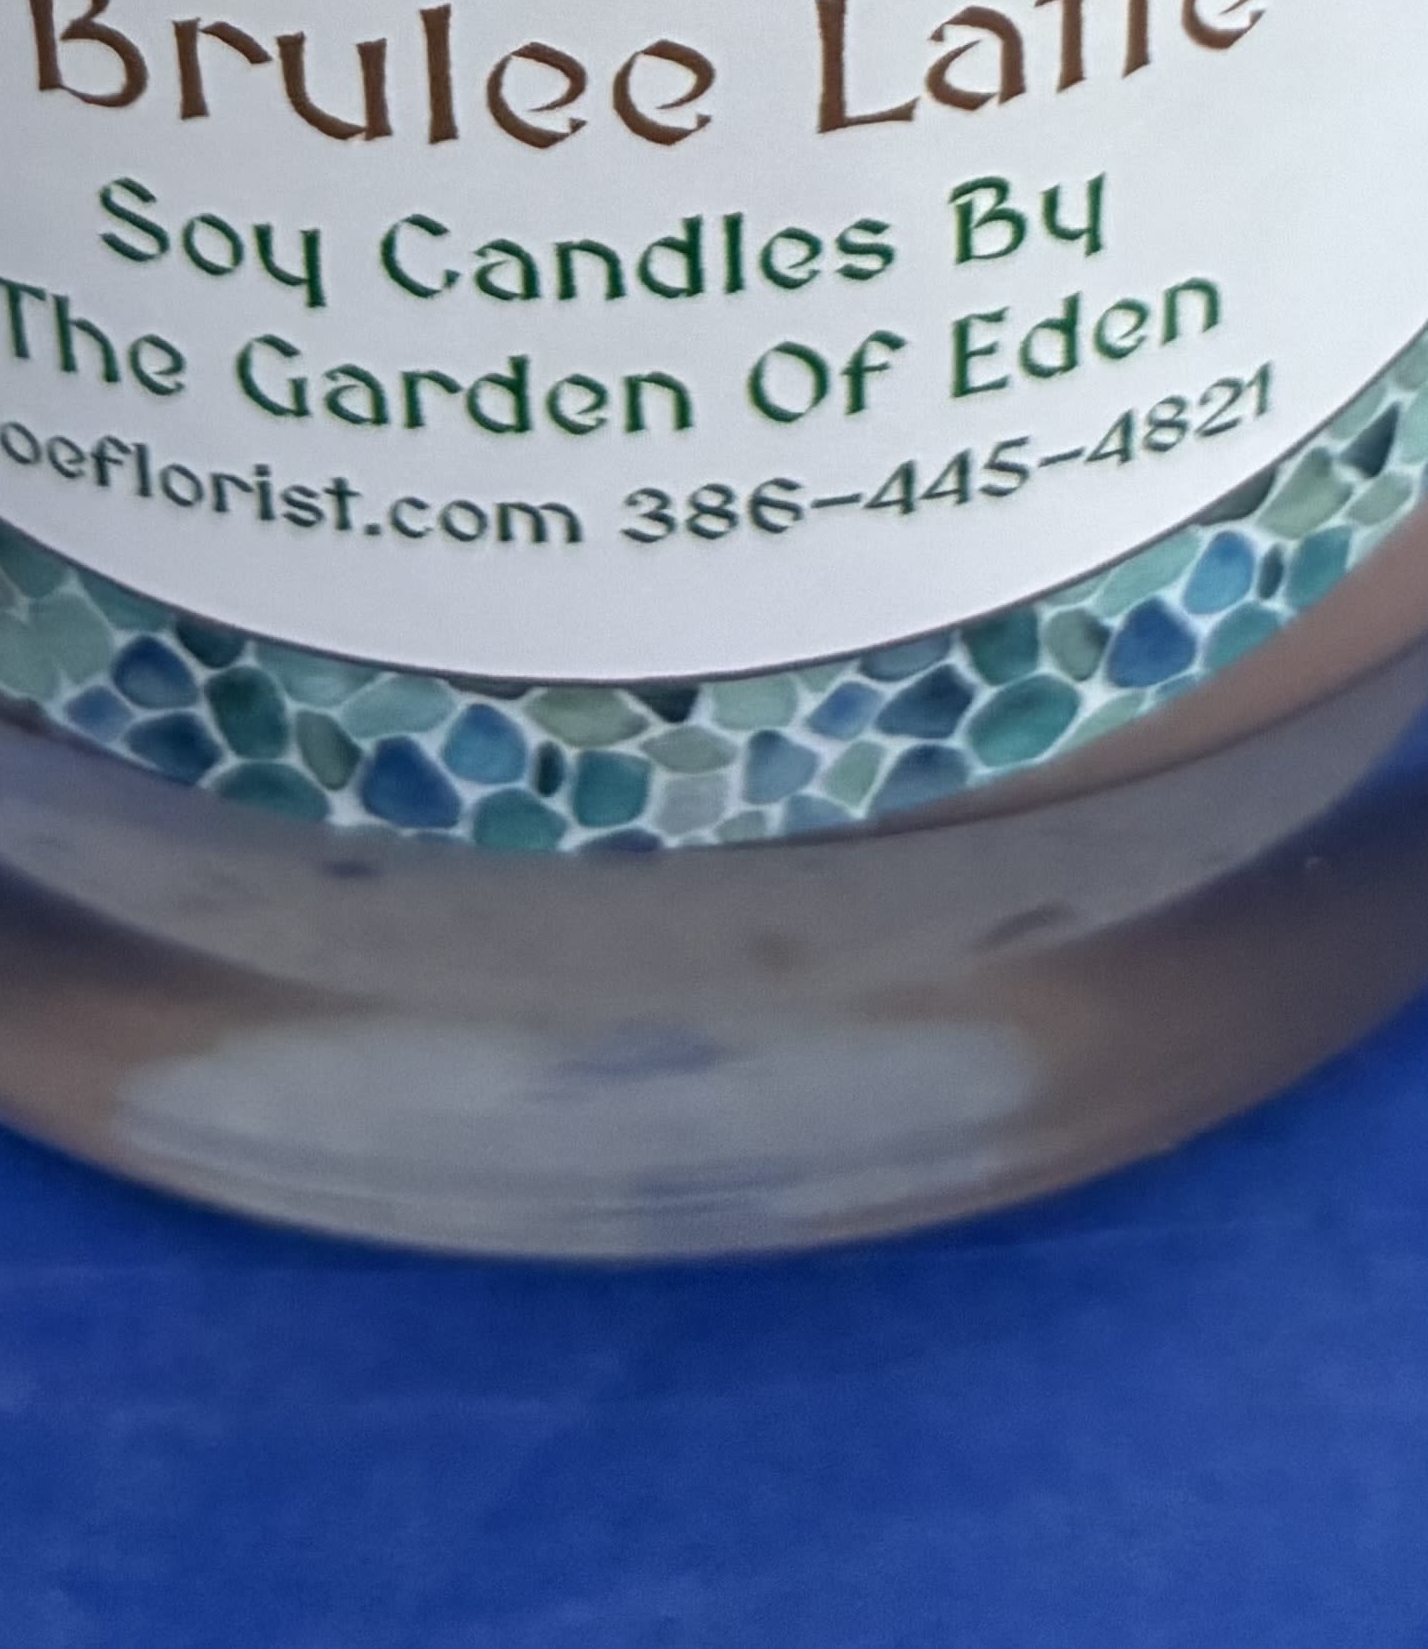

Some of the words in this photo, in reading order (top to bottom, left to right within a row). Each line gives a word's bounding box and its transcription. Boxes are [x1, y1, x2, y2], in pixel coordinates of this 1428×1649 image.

[98, 177, 328, 310] Soy
[379, 211, 897, 304] Candles
[947, 171, 1107, 266] By
[234, 333, 695, 437] Garden
[745, 329, 909, 426] Of
[949, 277, 1222, 400] Eden
[619, 361, 1273, 545] 386-445-4821
